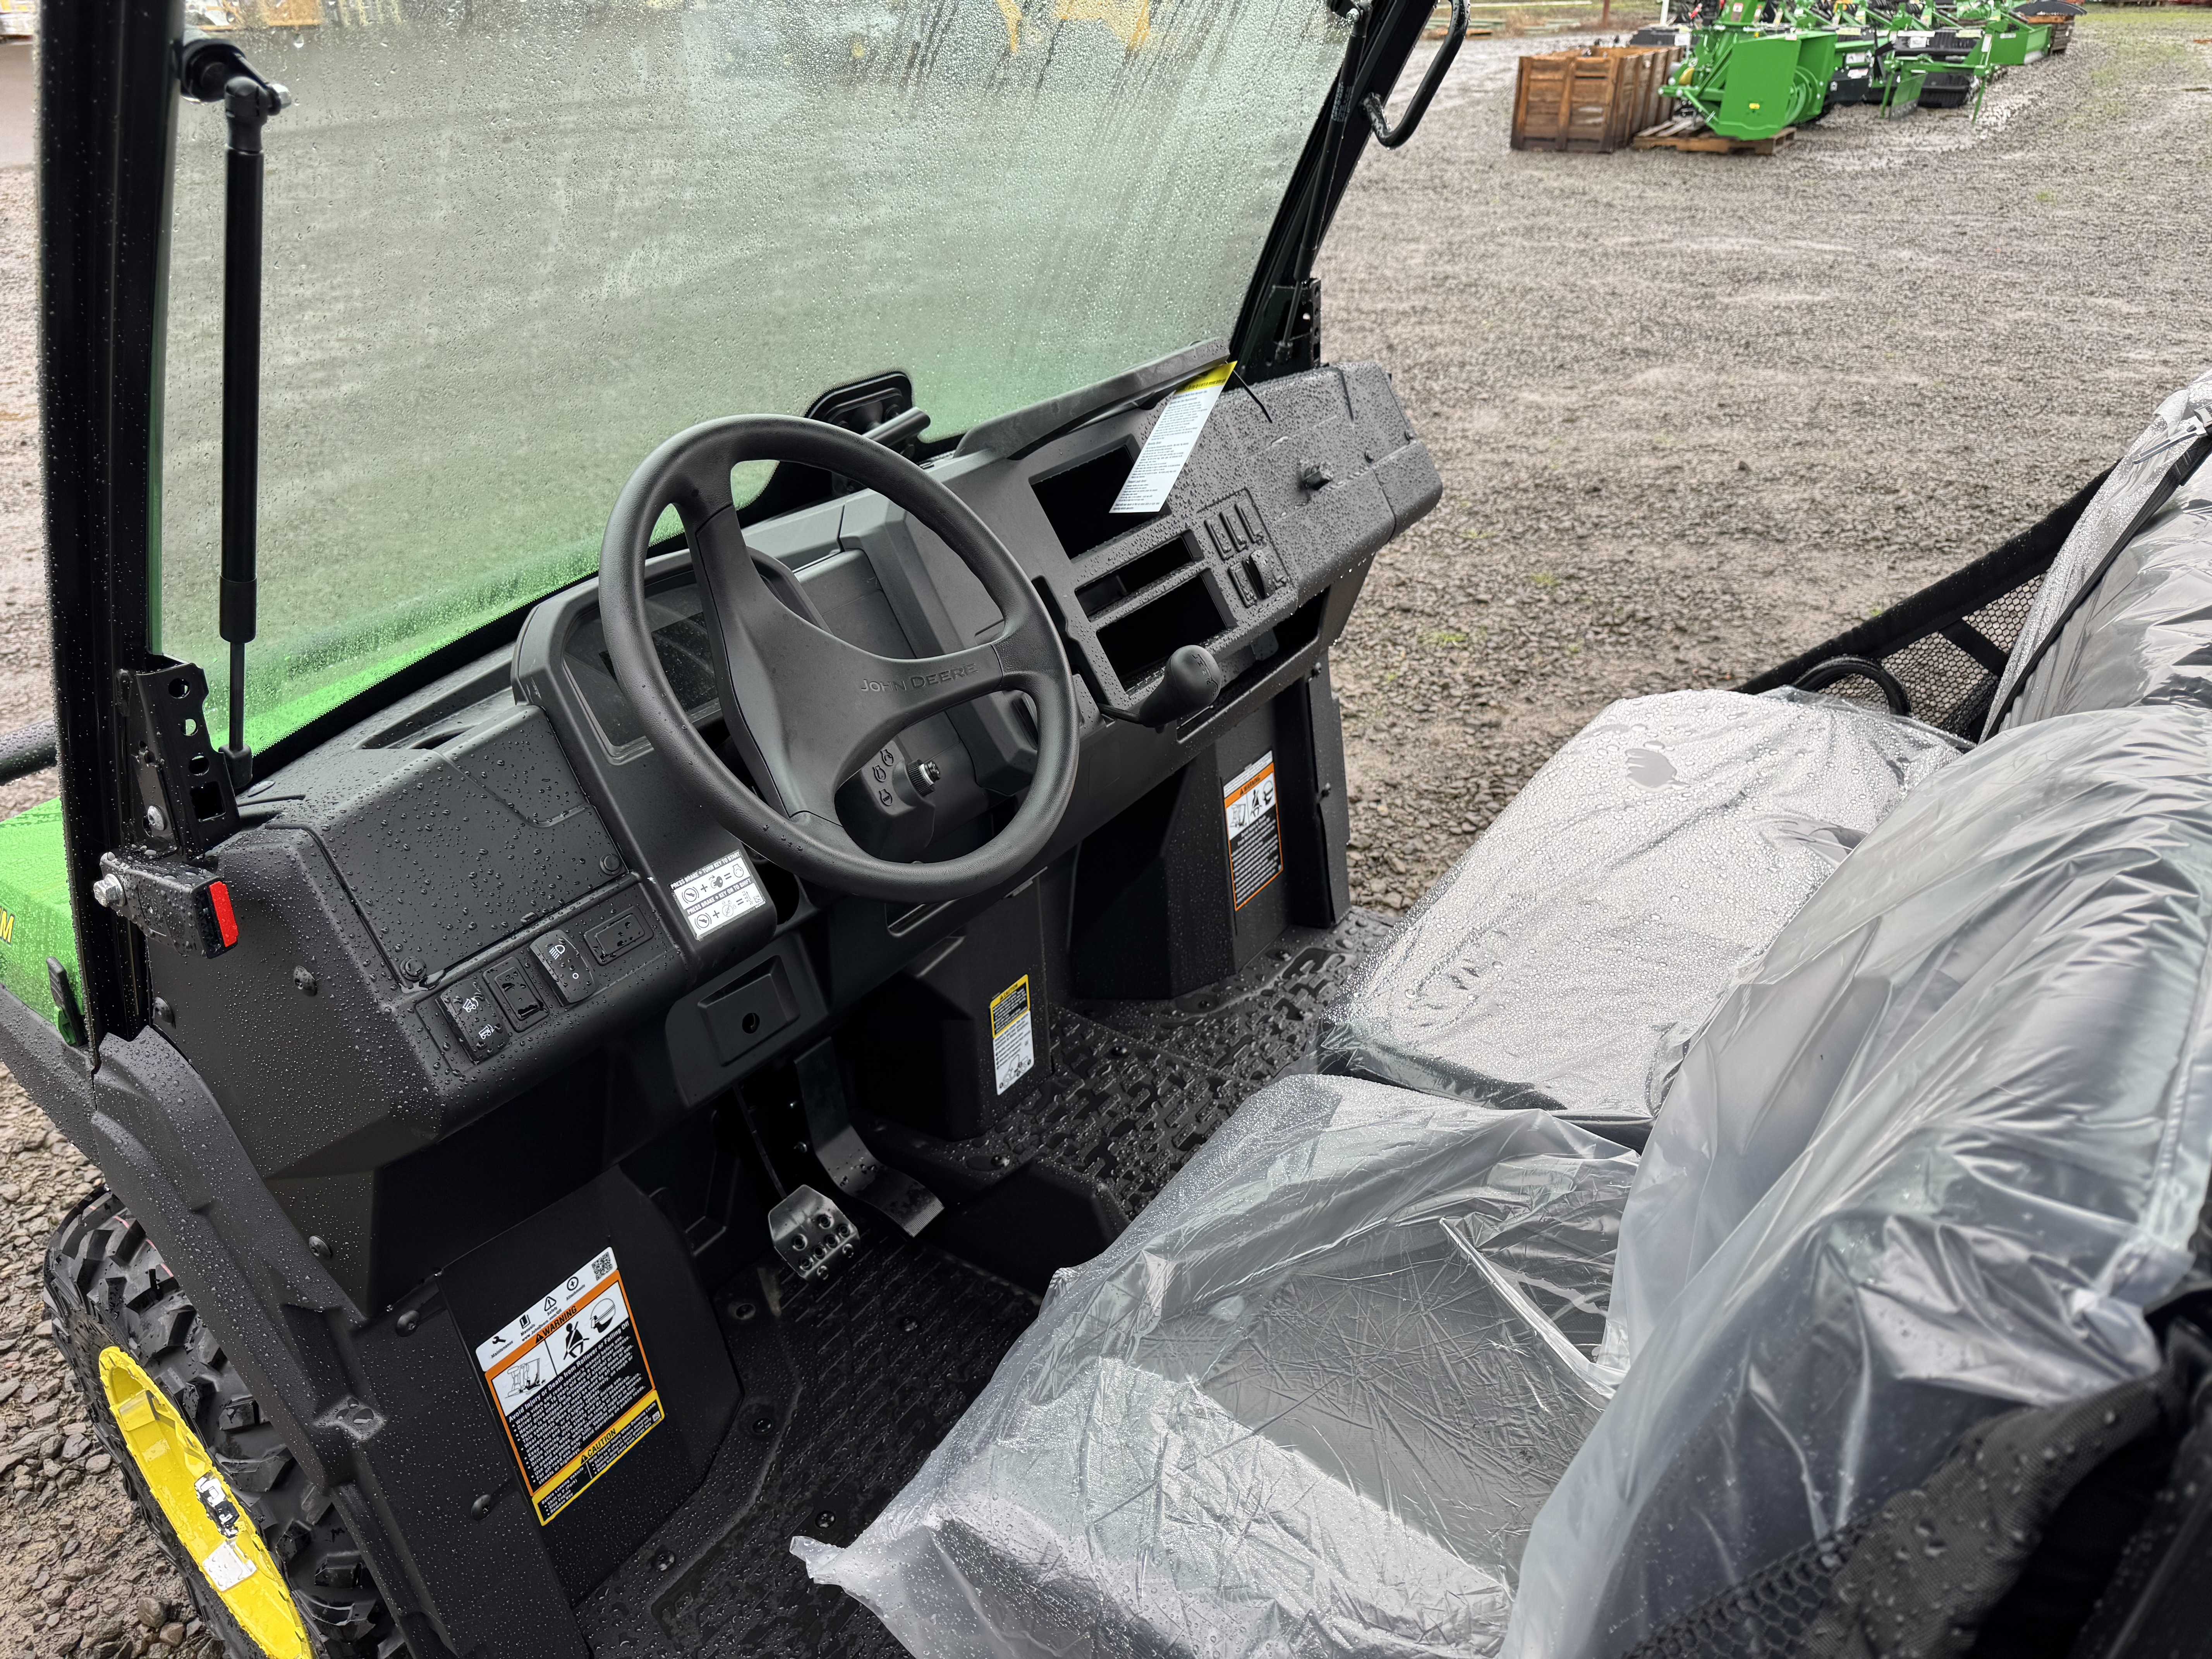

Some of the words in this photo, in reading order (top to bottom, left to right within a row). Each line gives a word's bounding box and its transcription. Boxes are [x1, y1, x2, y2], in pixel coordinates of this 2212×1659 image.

[860, 678, 907, 692] JOHN
[910, 663, 979, 689] DEERE
[671, 880, 685, 889] PRESS
[685, 873, 698, 882] BRAKE
[727, 852, 740, 860] START
[687, 904, 701, 914] PRESS
[701, 897, 714, 907] BRAKE
[739, 879, 751, 887] SHIFT
[543, 1305, 576, 1336] WARNING
[547, 1306, 557, 1316] Safety
[521, 1323, 534, 1336] Manuals
[491, 1340, 513, 1358] Maintenance
[508, 1407, 524, 1423] Avoid
[525, 1393, 540, 1410] Injury
[541, 1388, 547, 1396] or
[548, 1375, 563, 1390] Death
[564, 1364, 575, 1377] from
[577, 1347, 597, 1367] Rollover
[598, 1342, 603, 1350] or
[605, 1328, 621, 1345] Falling
[587, 1429, 615, 1456] CAUTION
